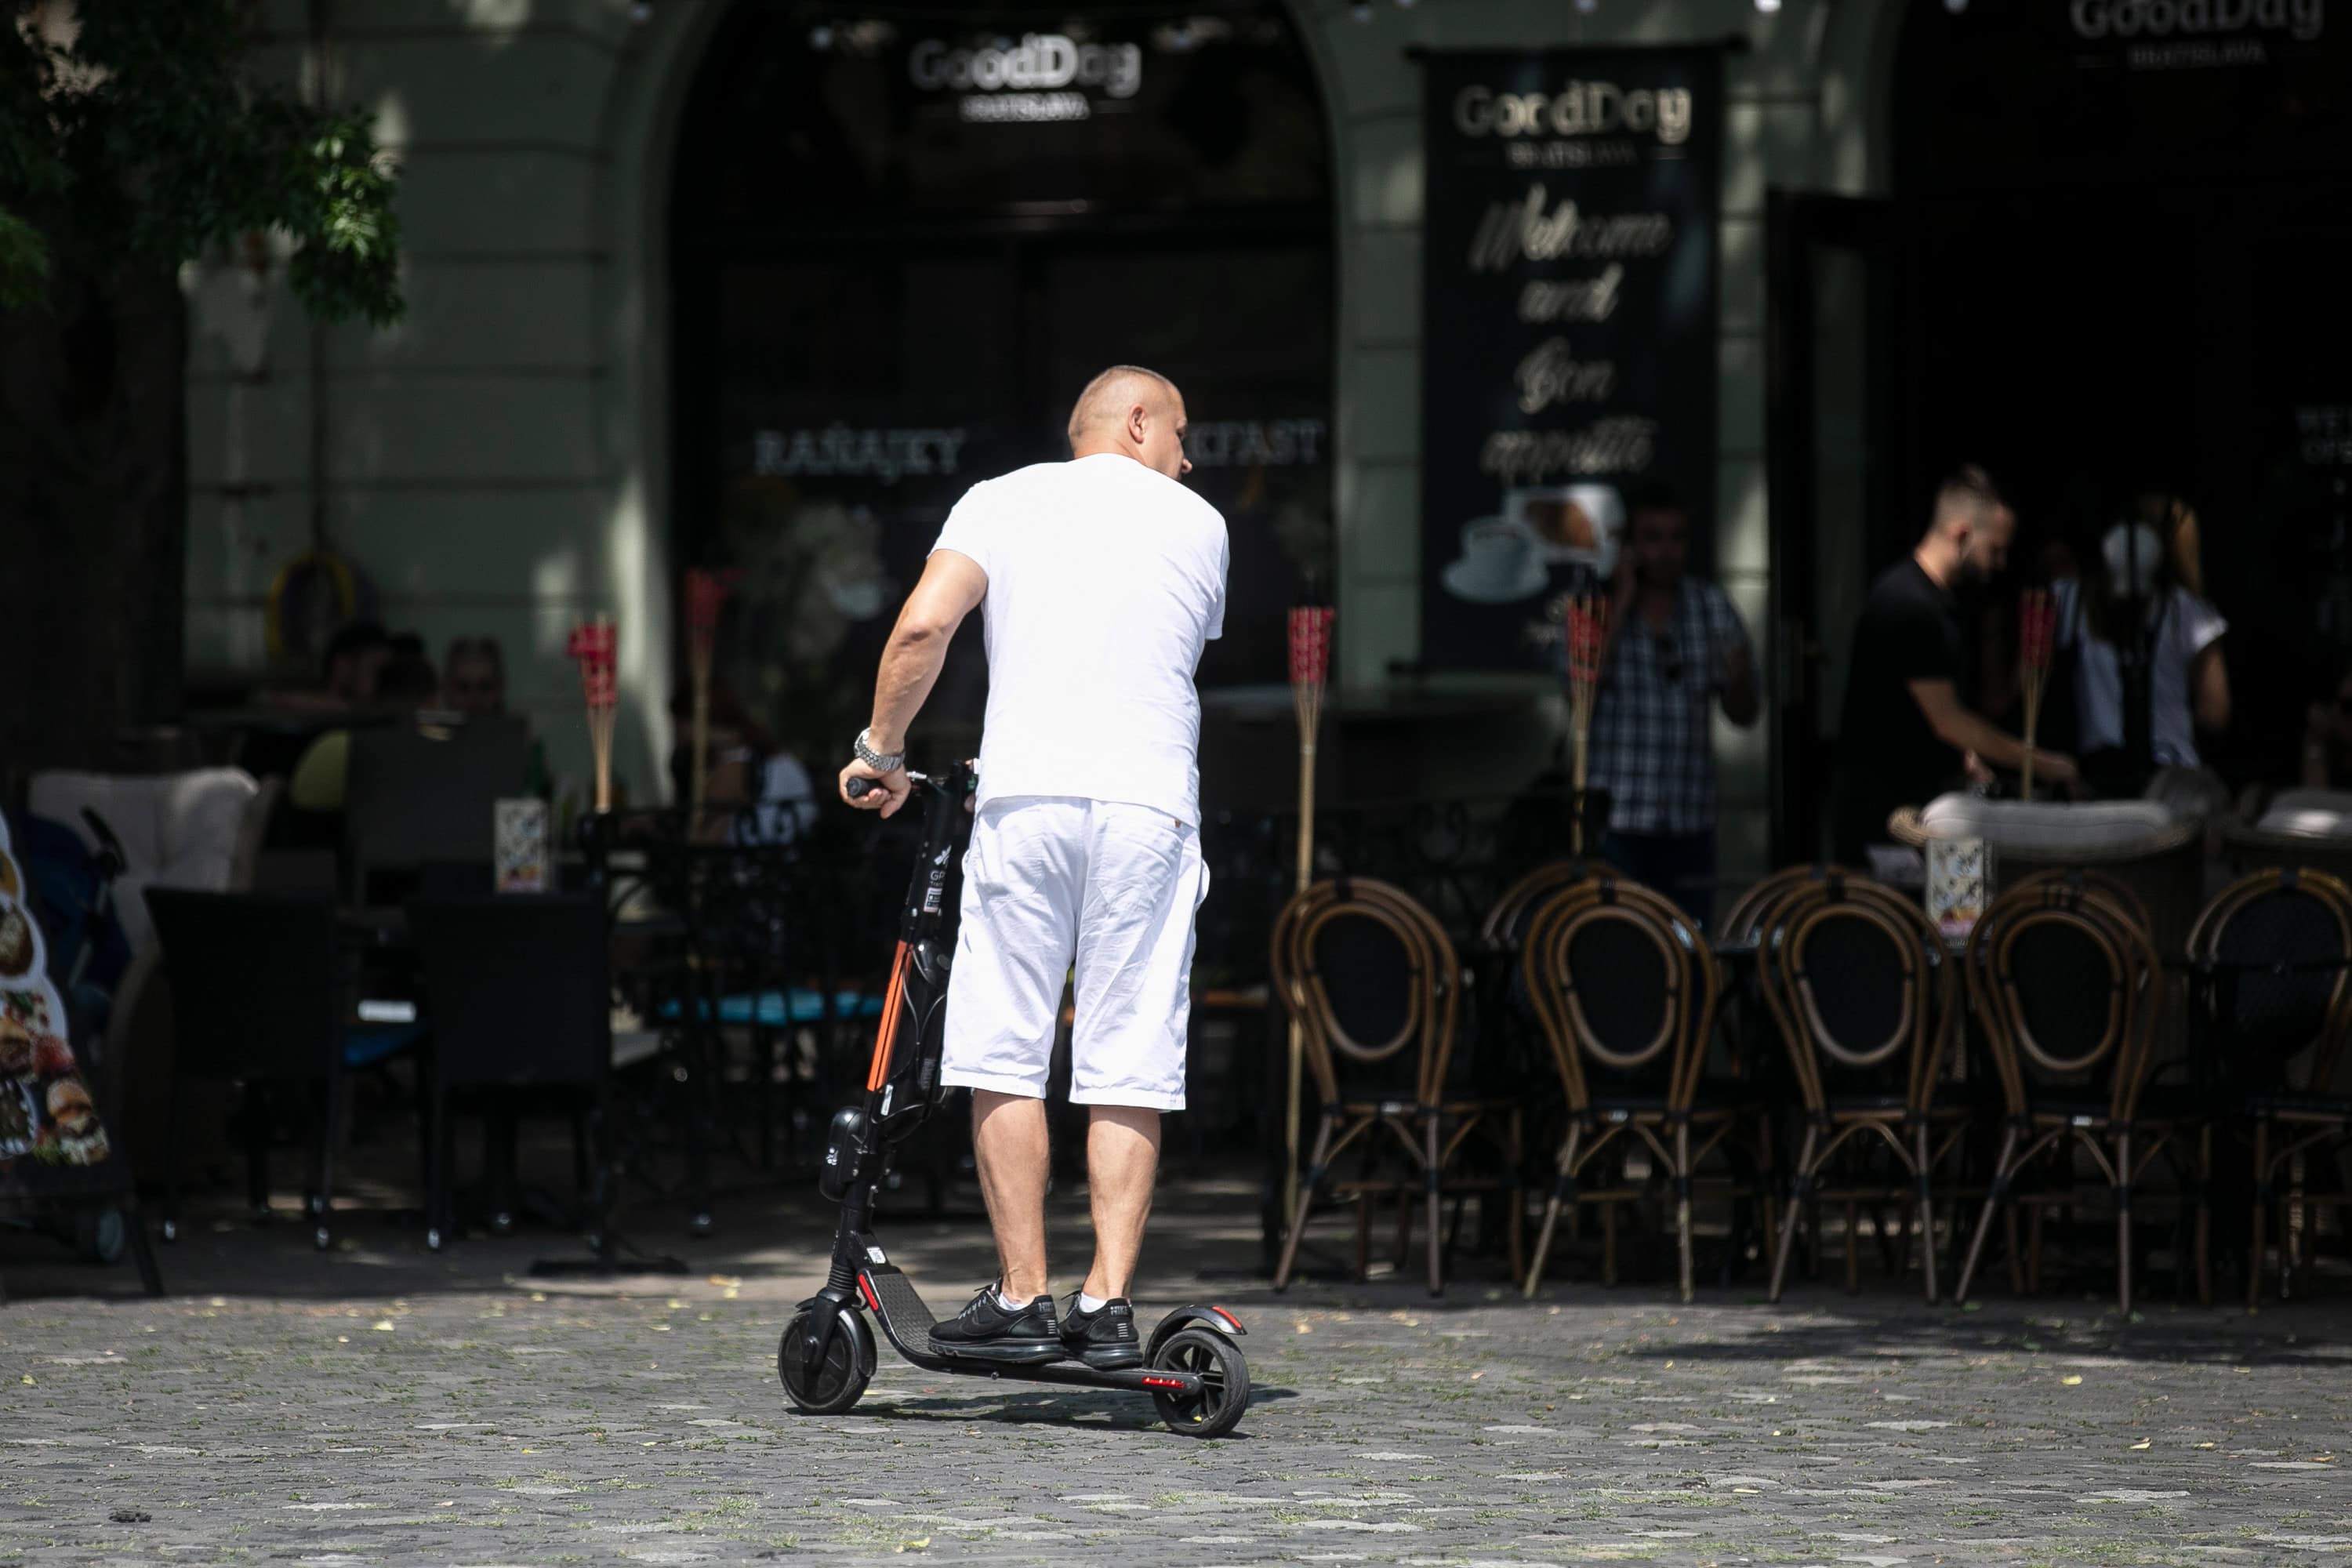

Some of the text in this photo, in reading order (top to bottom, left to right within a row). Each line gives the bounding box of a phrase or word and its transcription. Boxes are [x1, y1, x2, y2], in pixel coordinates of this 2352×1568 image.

[908, 32, 1142, 99] GoodDay
[1454, 79, 1692, 144] GoodDay
[1467, 182, 1673, 274] Welcome
[1518, 261, 1625, 324] and
[1514, 336, 1617, 414] Bon
